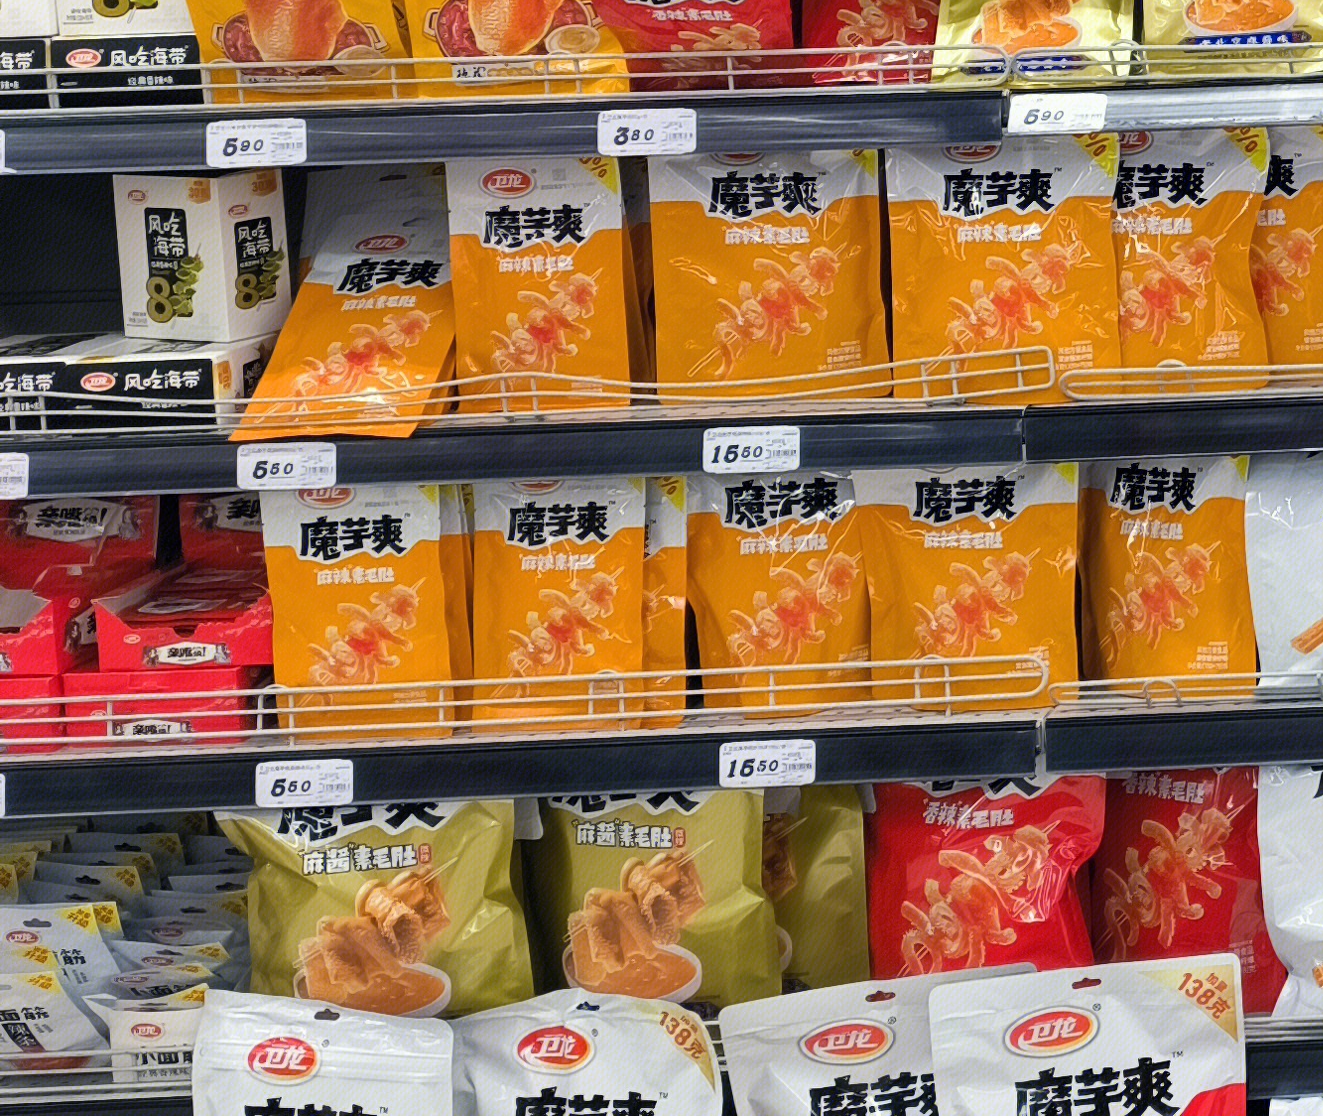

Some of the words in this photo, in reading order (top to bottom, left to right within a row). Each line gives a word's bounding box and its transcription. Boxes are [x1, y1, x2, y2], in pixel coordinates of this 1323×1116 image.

[709, 169, 822, 216] 魔芋爽
[482, 203, 588, 249] 魔芋爽
[335, 256, 444, 295] 魔芋爽
[299, 513, 406, 560] 魔芋爽
[817, 1026, 877, 1056] 卫龙
[1019, 1013, 1086, 1046] 卫龙
[253, 1041, 314, 1076] 卫龙
[521, 1032, 581, 1069] 卫龙
